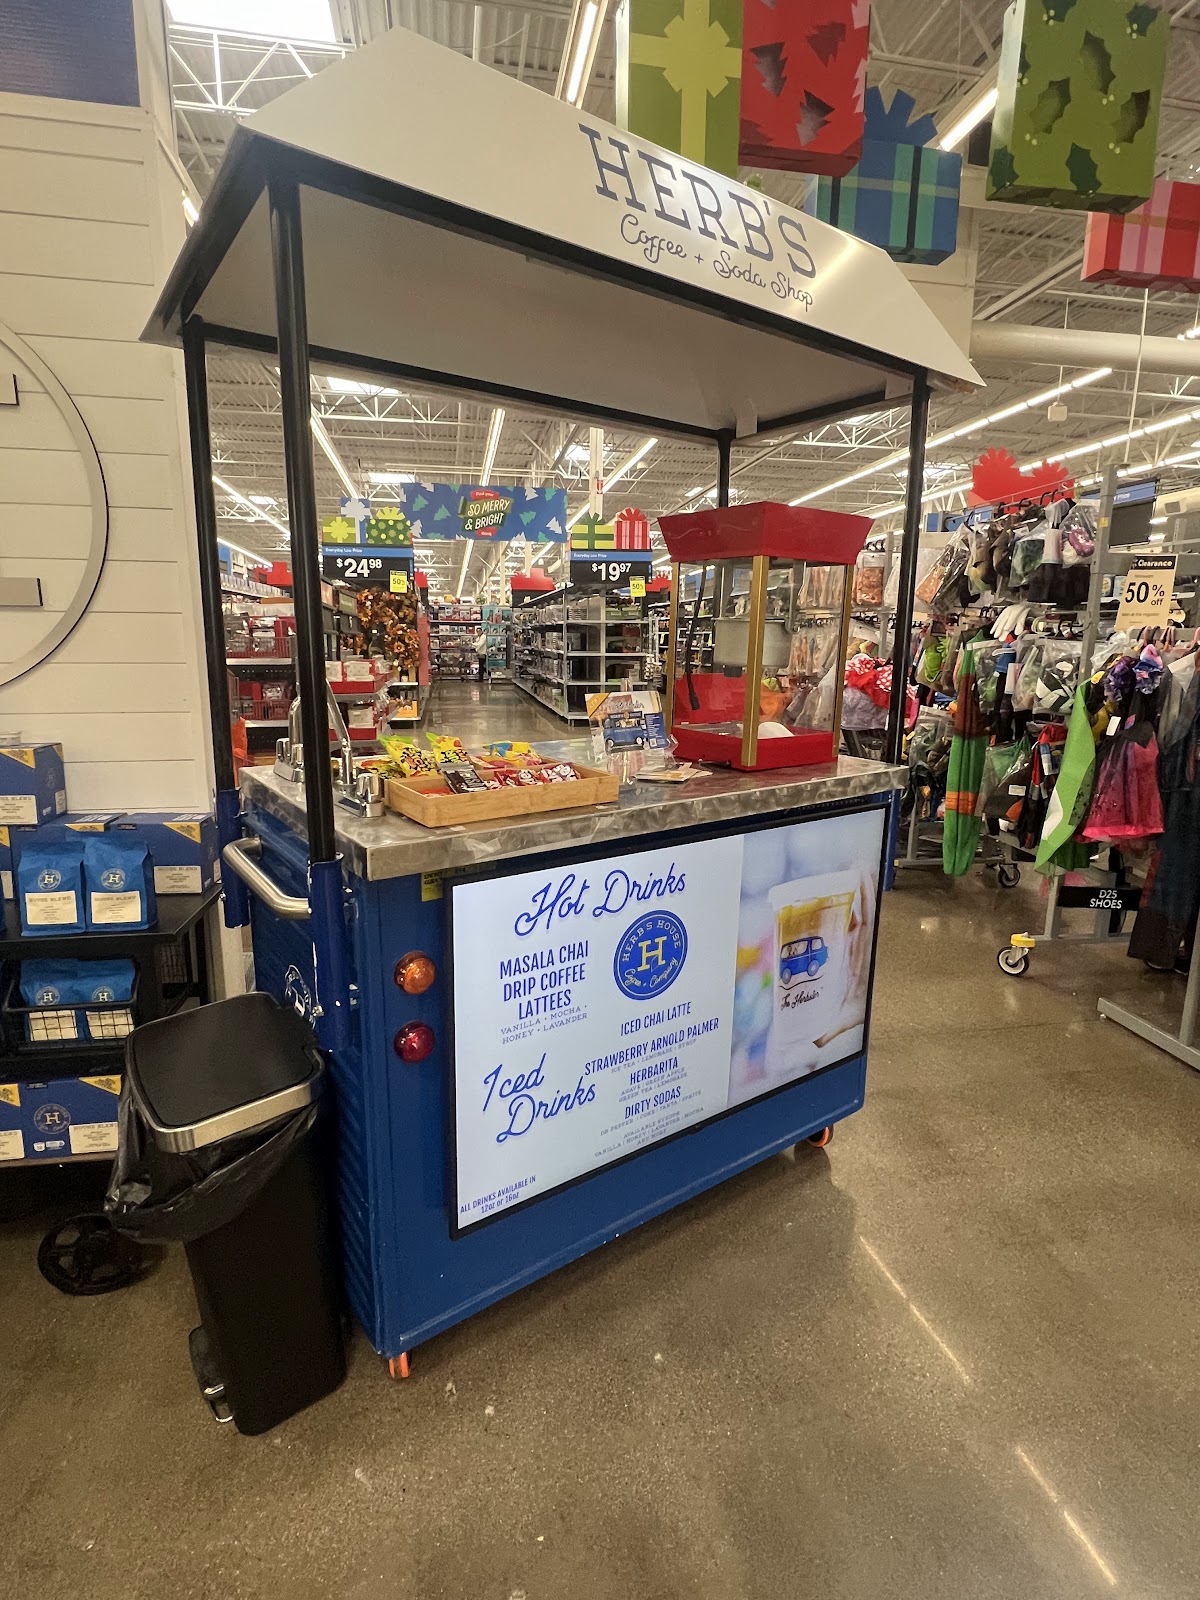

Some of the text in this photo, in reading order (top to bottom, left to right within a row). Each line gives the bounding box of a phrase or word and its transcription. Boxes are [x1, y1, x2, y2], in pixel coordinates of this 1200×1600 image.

[578, 123, 816, 279] HERB'S
[620, 213, 814, 312] Coffee + Soda Shop
[464, 512, 505, 530] & BRIGHT
[468, 499, 510, 516] SO MERRY
[1138, 559, 1173, 568] Clearance
[1125, 581, 1150, 604] 50
[1150, 598, 1164, 606] off
[514, 862, 686, 937] Hot Drinks
[1090, 898, 1122, 910] SHOES
[1098, 890, 1118, 900] D25
[656, 920, 681, 948] HOUSE
[500, 940, 589, 980] MASALA CHAI
[638, 936, 668, 972] H
[503, 963, 586, 1002] DRIP COFFEE
[501, 1006, 582, 1035] VANILLA MOCHA
[518, 989, 571, 1020] LATTEES
[620, 1001, 692, 1036] ICED CHAI LATTE
[502, 1012, 588, 1044] HONEY LAVANDER
[584, 1017, 720, 1076] STRAWBERRY ARNOLD PALMER
[482, 1052, 547, 1112] Iced
[630, 1056, 678, 1086] HERBARITA
[44, 1112, 61, 1125] H
[496, 1075, 596, 1143] Drinks
[625, 1085, 681, 1120] DIRTY SODAS
[460, 1174, 536, 1214] ALL DRINKS AVAILABLE IN
